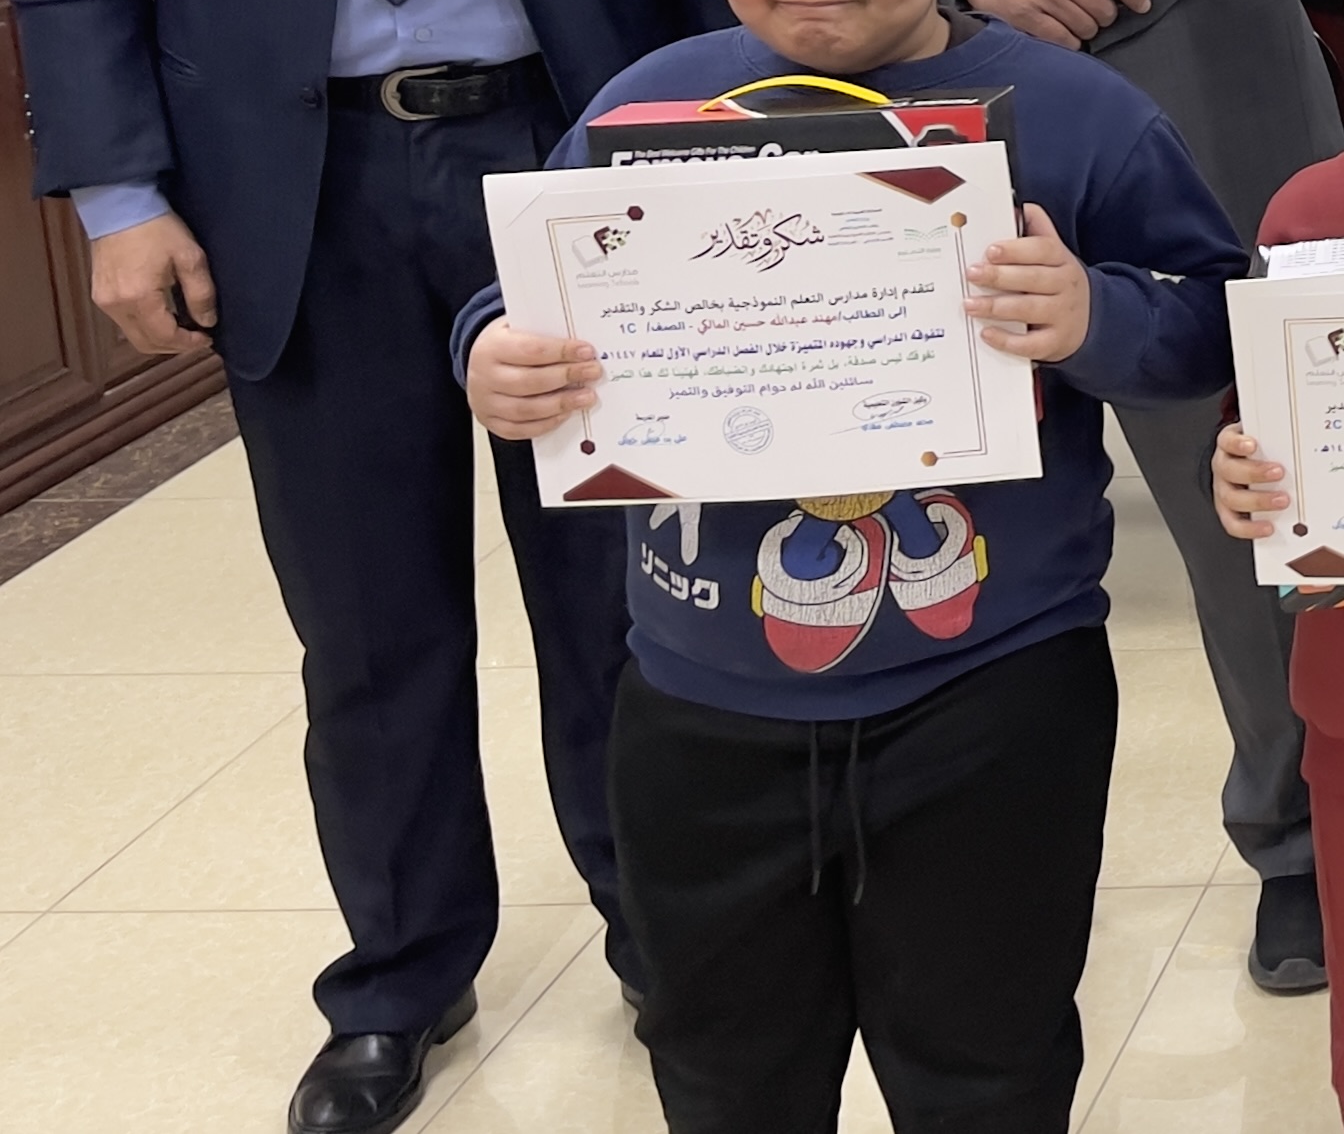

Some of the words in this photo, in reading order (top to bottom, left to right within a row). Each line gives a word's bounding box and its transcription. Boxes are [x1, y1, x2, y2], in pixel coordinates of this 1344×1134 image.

[757, 214, 824, 273] شكر
[827, 290, 868, 307] مدارس
[871, 286, 898, 301] إدارة
[901, 281, 935, 300] تتقدم
[648, 299, 681, 316] الشكر
[684, 298, 725, 315] بخالص
[727, 294, 787, 312] النموذجية
[790, 292, 824, 310] التعلم
[599, 302, 646, 319] والتقدير
